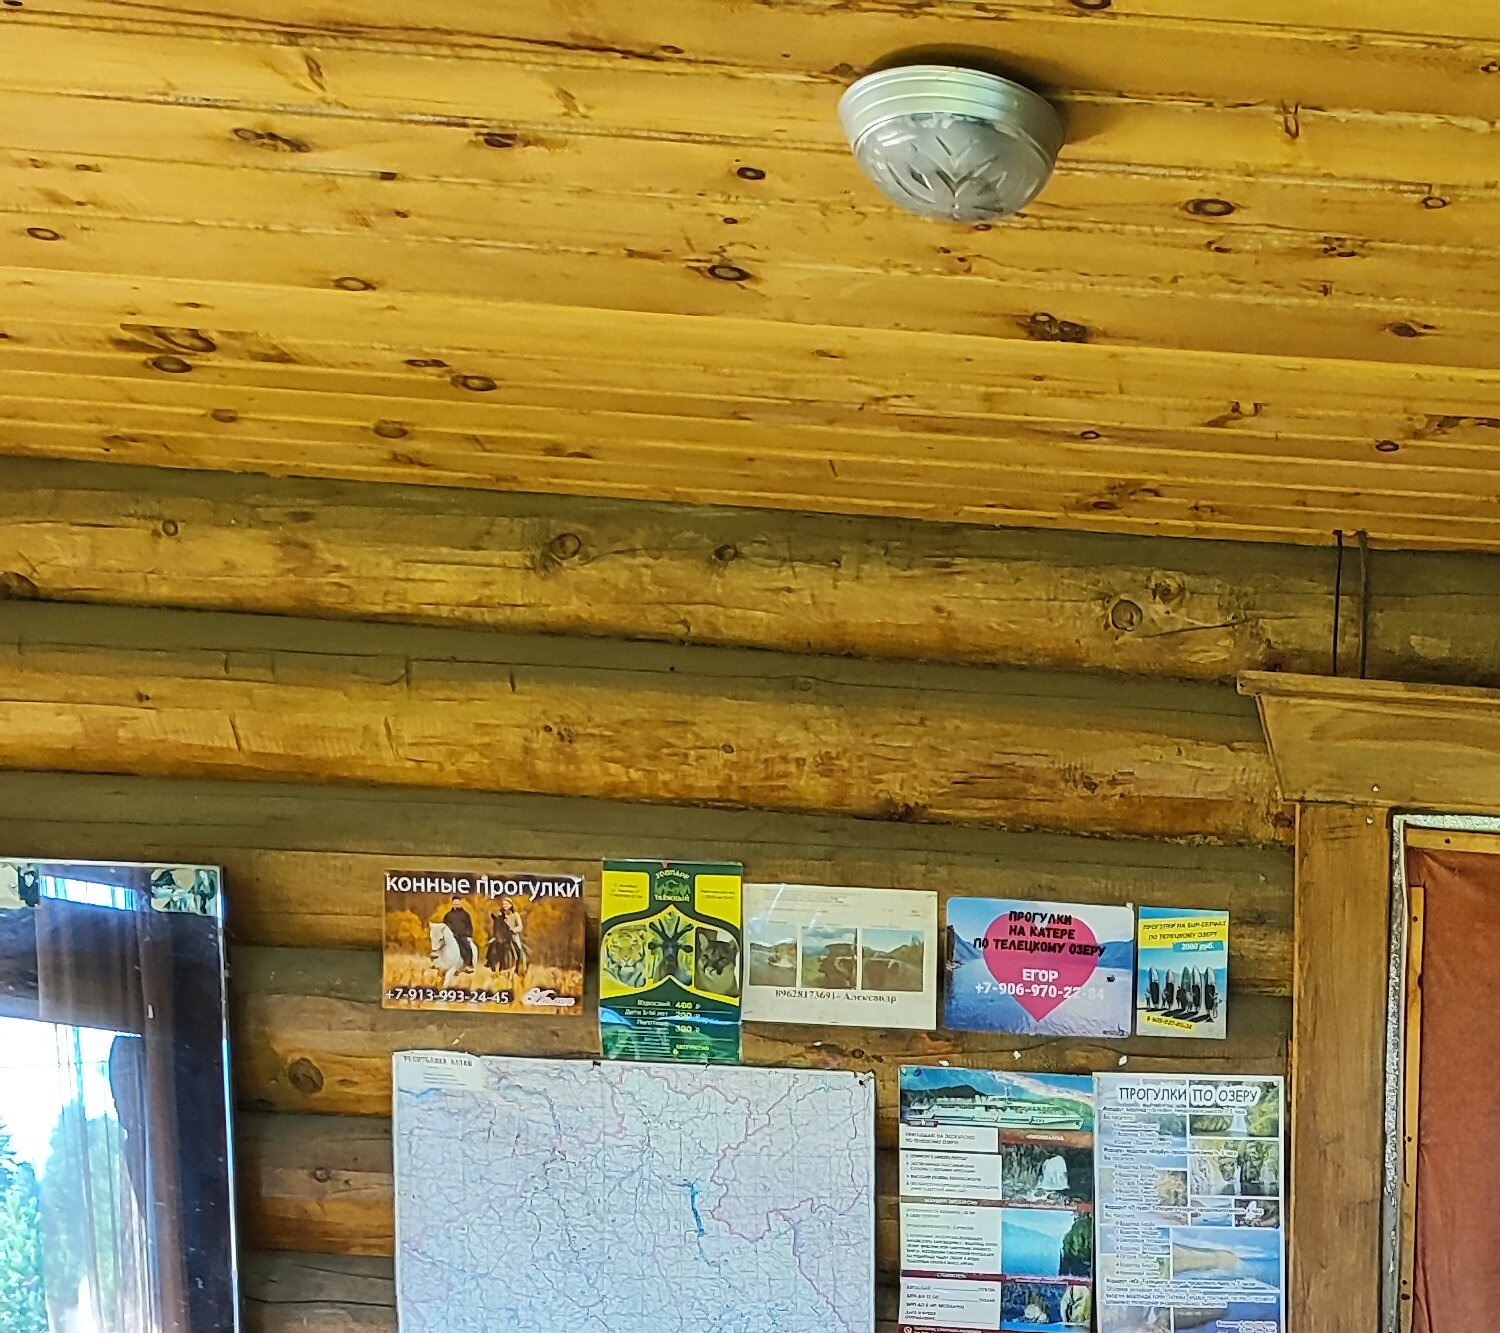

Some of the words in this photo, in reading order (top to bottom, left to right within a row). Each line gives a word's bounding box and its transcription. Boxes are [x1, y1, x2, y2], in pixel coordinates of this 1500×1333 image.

[386, 875, 471, 894] конные
[476, 877, 582, 902] прогулки
[1008, 910, 1073, 925] ПРОГУЛКИ
[1008, 925, 1026, 937] НА
[1029, 927, 1076, 940] КАТЕРЕ
[973, 937, 989, 949] ПО
[993, 938, 1066, 954] ТЕЛЕЦКОМУ
[1068, 945, 1107, 958] ОЗЕРУ
[1022, 968, 1059, 982] ЕГОР
[385, 988, 509, 1004] +7-913-993-24-45
[1119, 1087, 1187, 1102] ПРОГУЛКИ
[1192, 1088, 1213, 1102] ПО
[1218, 1089, 1260, 1103] ОЗЕРУ
